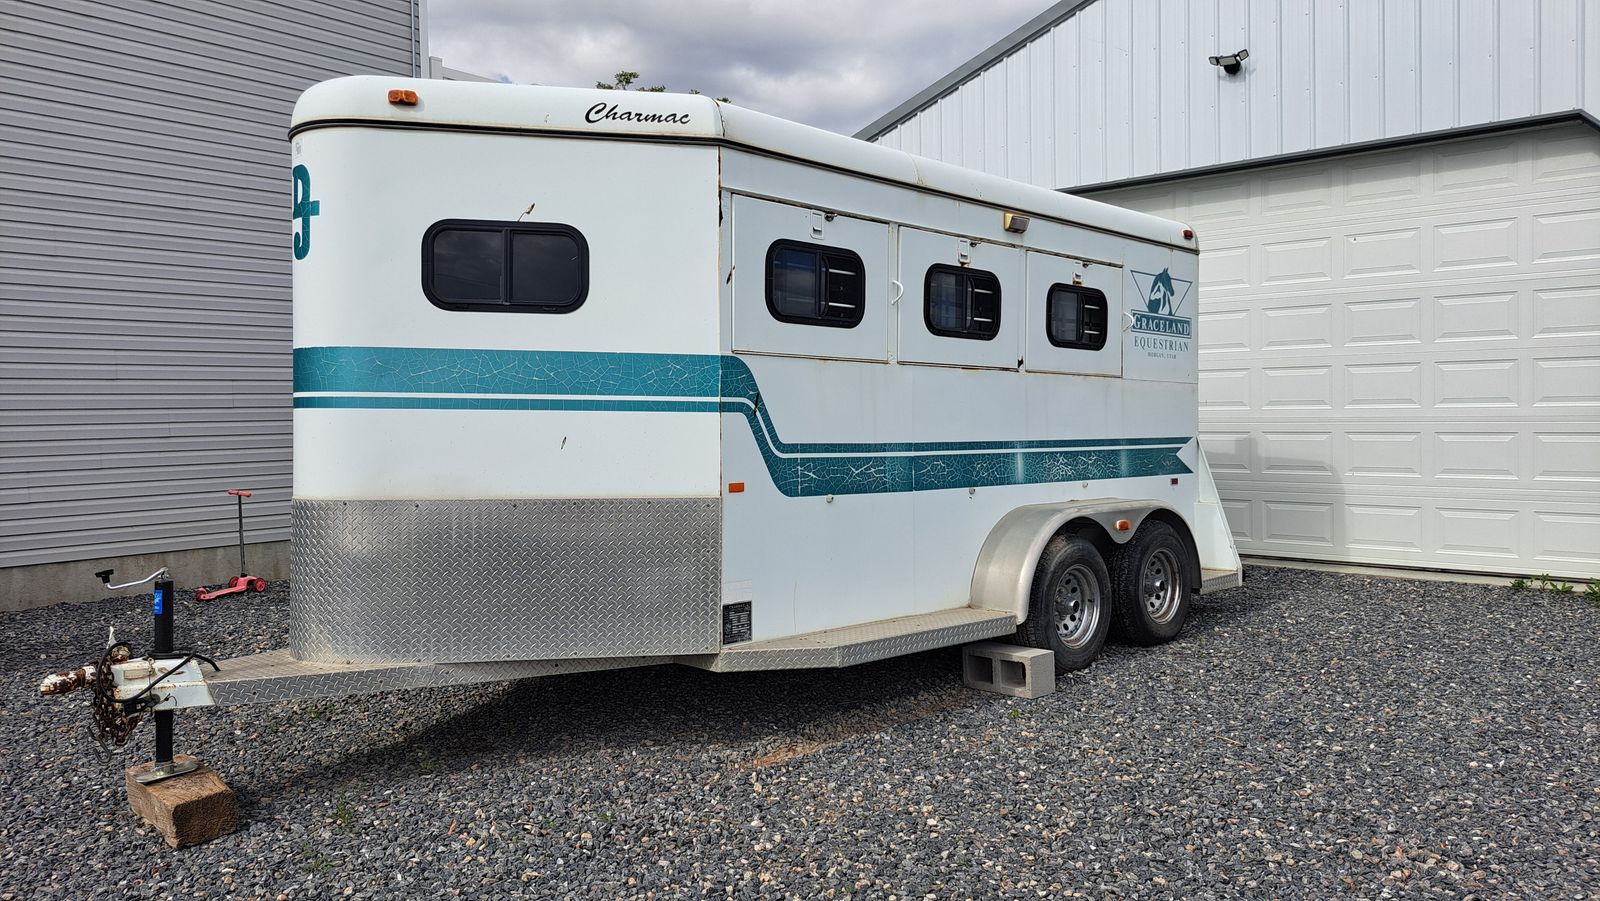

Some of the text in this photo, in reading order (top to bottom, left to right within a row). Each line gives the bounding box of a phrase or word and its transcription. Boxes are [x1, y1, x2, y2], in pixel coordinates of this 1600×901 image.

[584, 102, 691, 125] Charmac
[1134, 314, 1189, 335] GRACELAND
[1134, 335, 1189, 352] EQUESTRIAN
